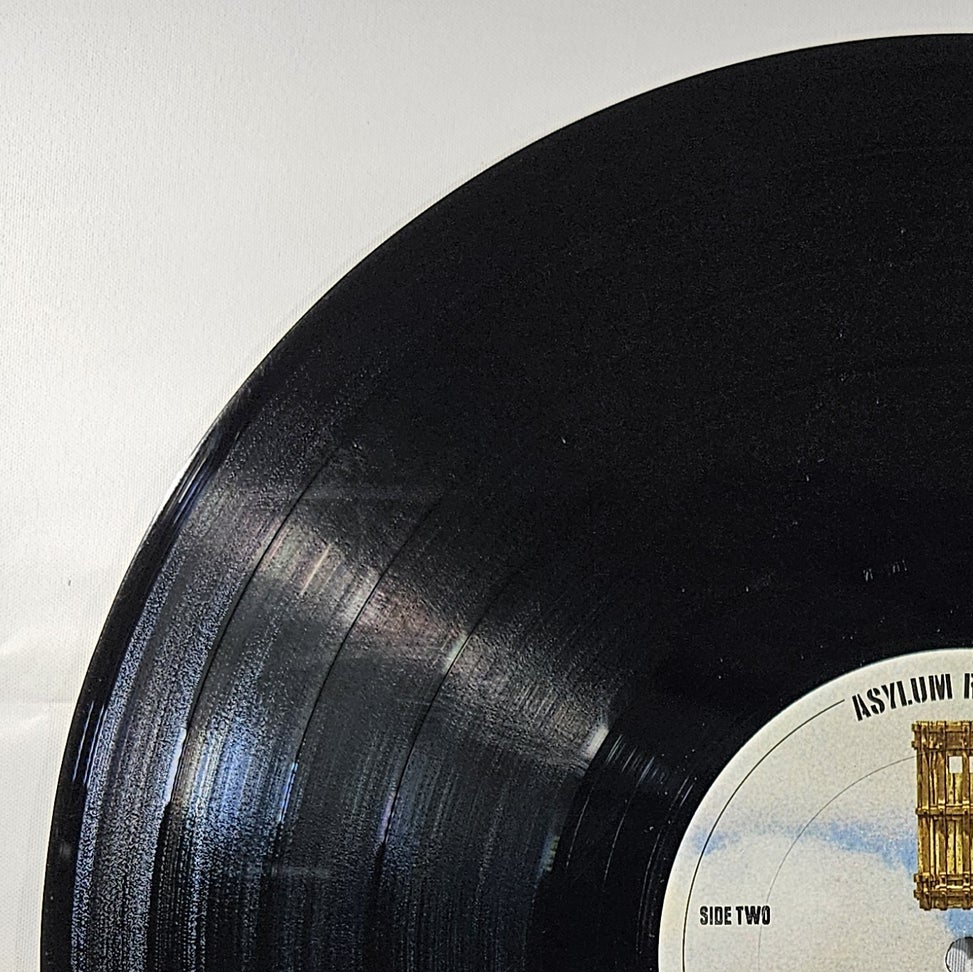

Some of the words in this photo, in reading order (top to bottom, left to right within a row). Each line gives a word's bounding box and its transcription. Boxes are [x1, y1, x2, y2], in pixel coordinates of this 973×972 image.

[852, 674, 953, 721] ASYLUM
[700, 906, 732, 925] SIDE
[735, 906, 771, 925] TWO
